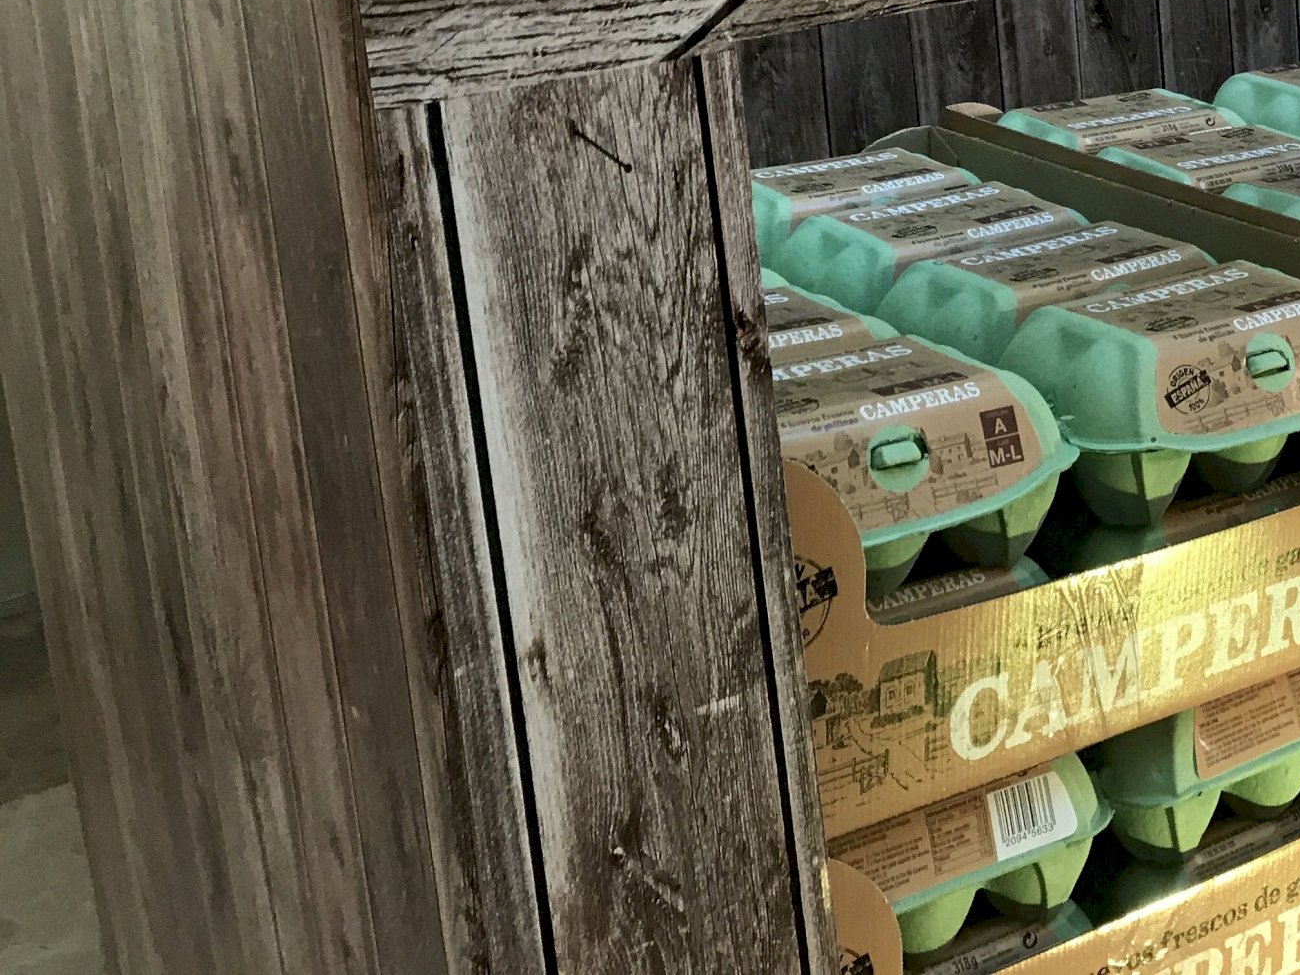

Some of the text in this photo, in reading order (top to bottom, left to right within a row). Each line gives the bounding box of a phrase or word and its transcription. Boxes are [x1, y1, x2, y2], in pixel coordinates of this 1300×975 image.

[755, 152, 897, 179] CAMPERAS
[861, 172, 945, 194] CAMPERAS
[850, 187, 999, 222] CAMPERAS
[966, 212, 1054, 239] CAMPERAS
[961, 227, 1118, 266] CAMPERAS
[1091, 250, 1182, 282] CAMPERAS
[1086, 268, 1248, 312] CAMPERAS
[768, 324, 843, 348] PERAS
[772, 345, 912, 381] MPERAS
[860, 382, 980, 420] CAMPERAS
[994, 418, 1007, 434] A
[989, 446, 1023, 467] M-L
[867, 568, 985, 612] CAMPERAS
[1005, 823, 1055, 848] 2094 5633
[1160, 902, 1247, 950] frescos
[1254, 884, 1280, 912] de
[953, 956, 979, 975] 318g
